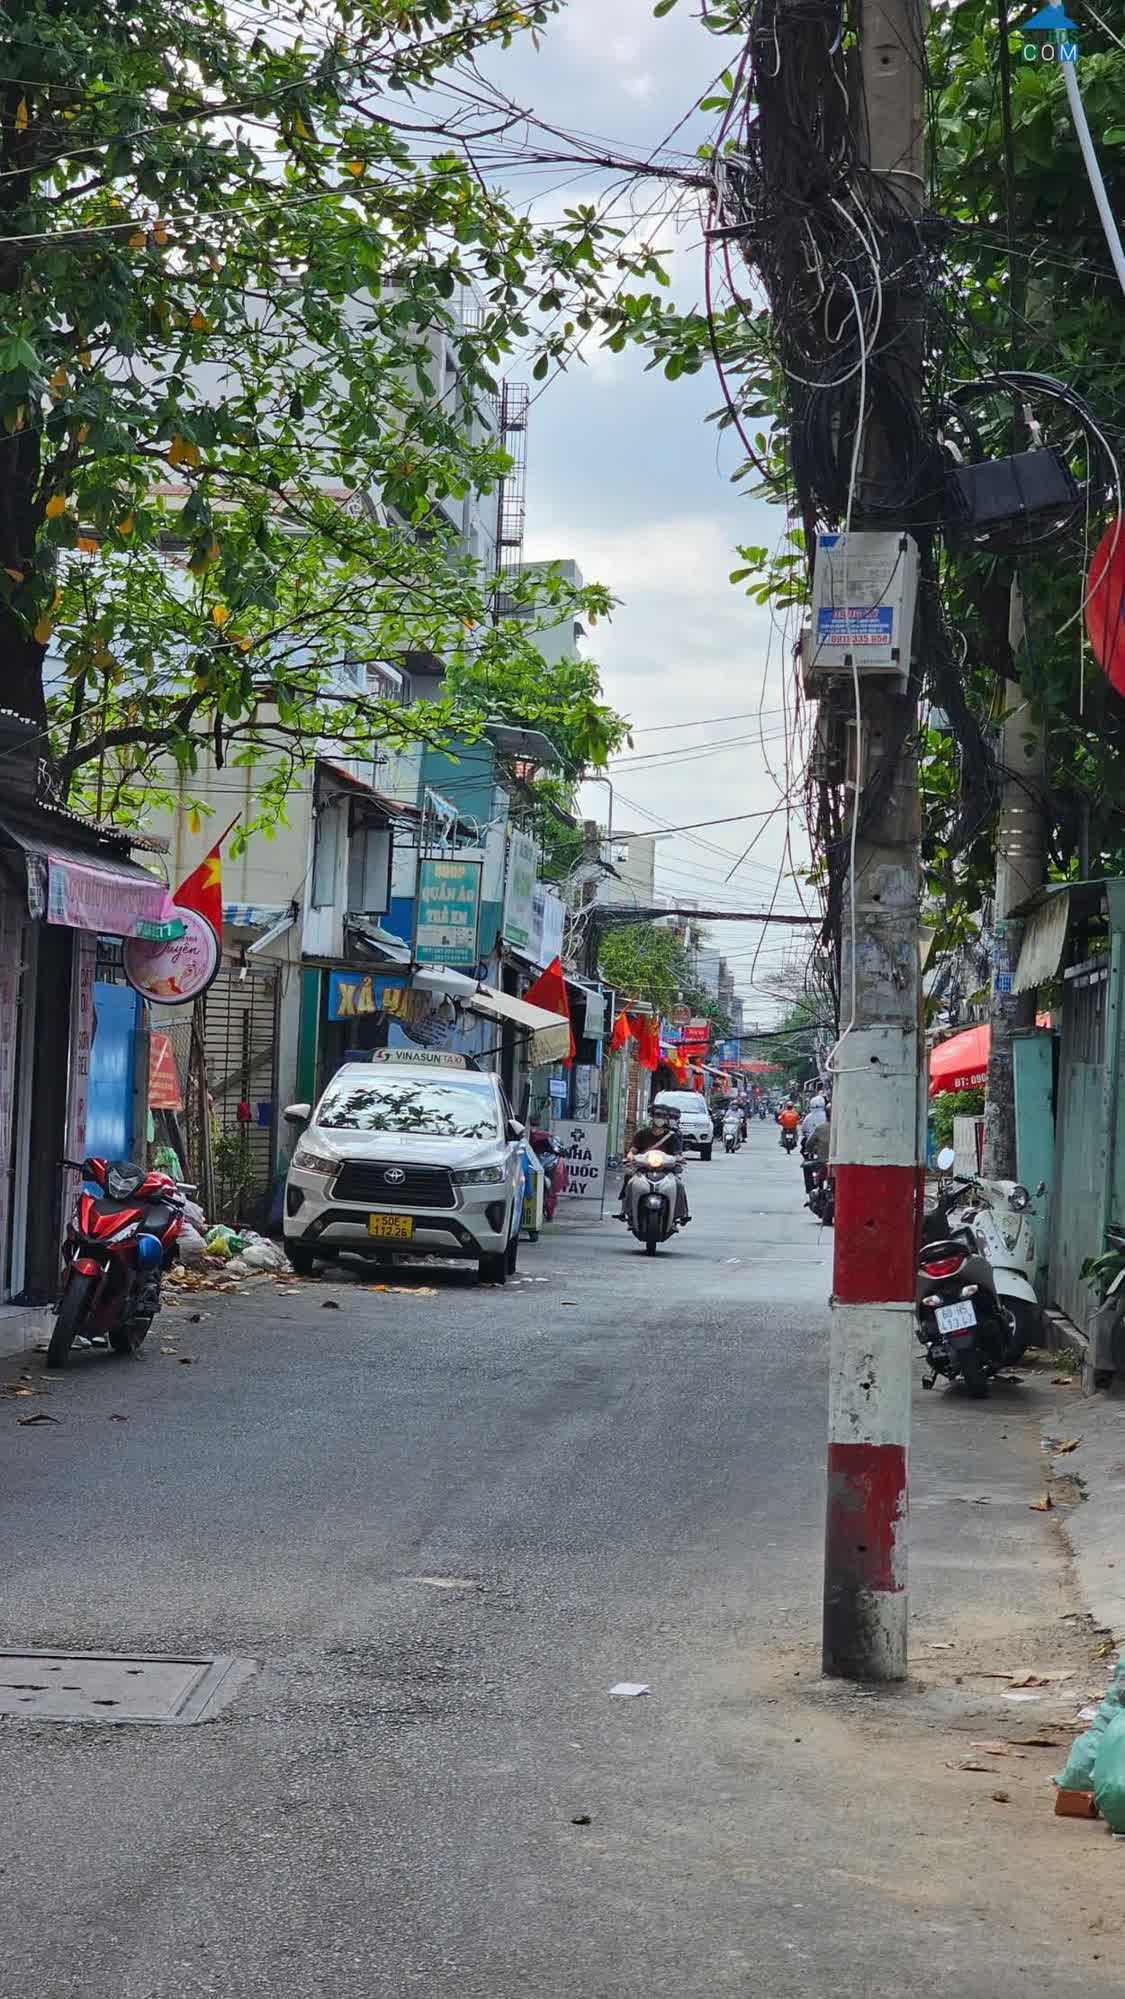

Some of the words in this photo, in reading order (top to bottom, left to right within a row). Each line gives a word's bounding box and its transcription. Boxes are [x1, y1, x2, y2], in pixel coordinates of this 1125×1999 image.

[337, 976, 376, 1016] XẢ
[396, 1051, 441, 1063] VINASUN
[443, 1055, 463, 1064] TAXI
